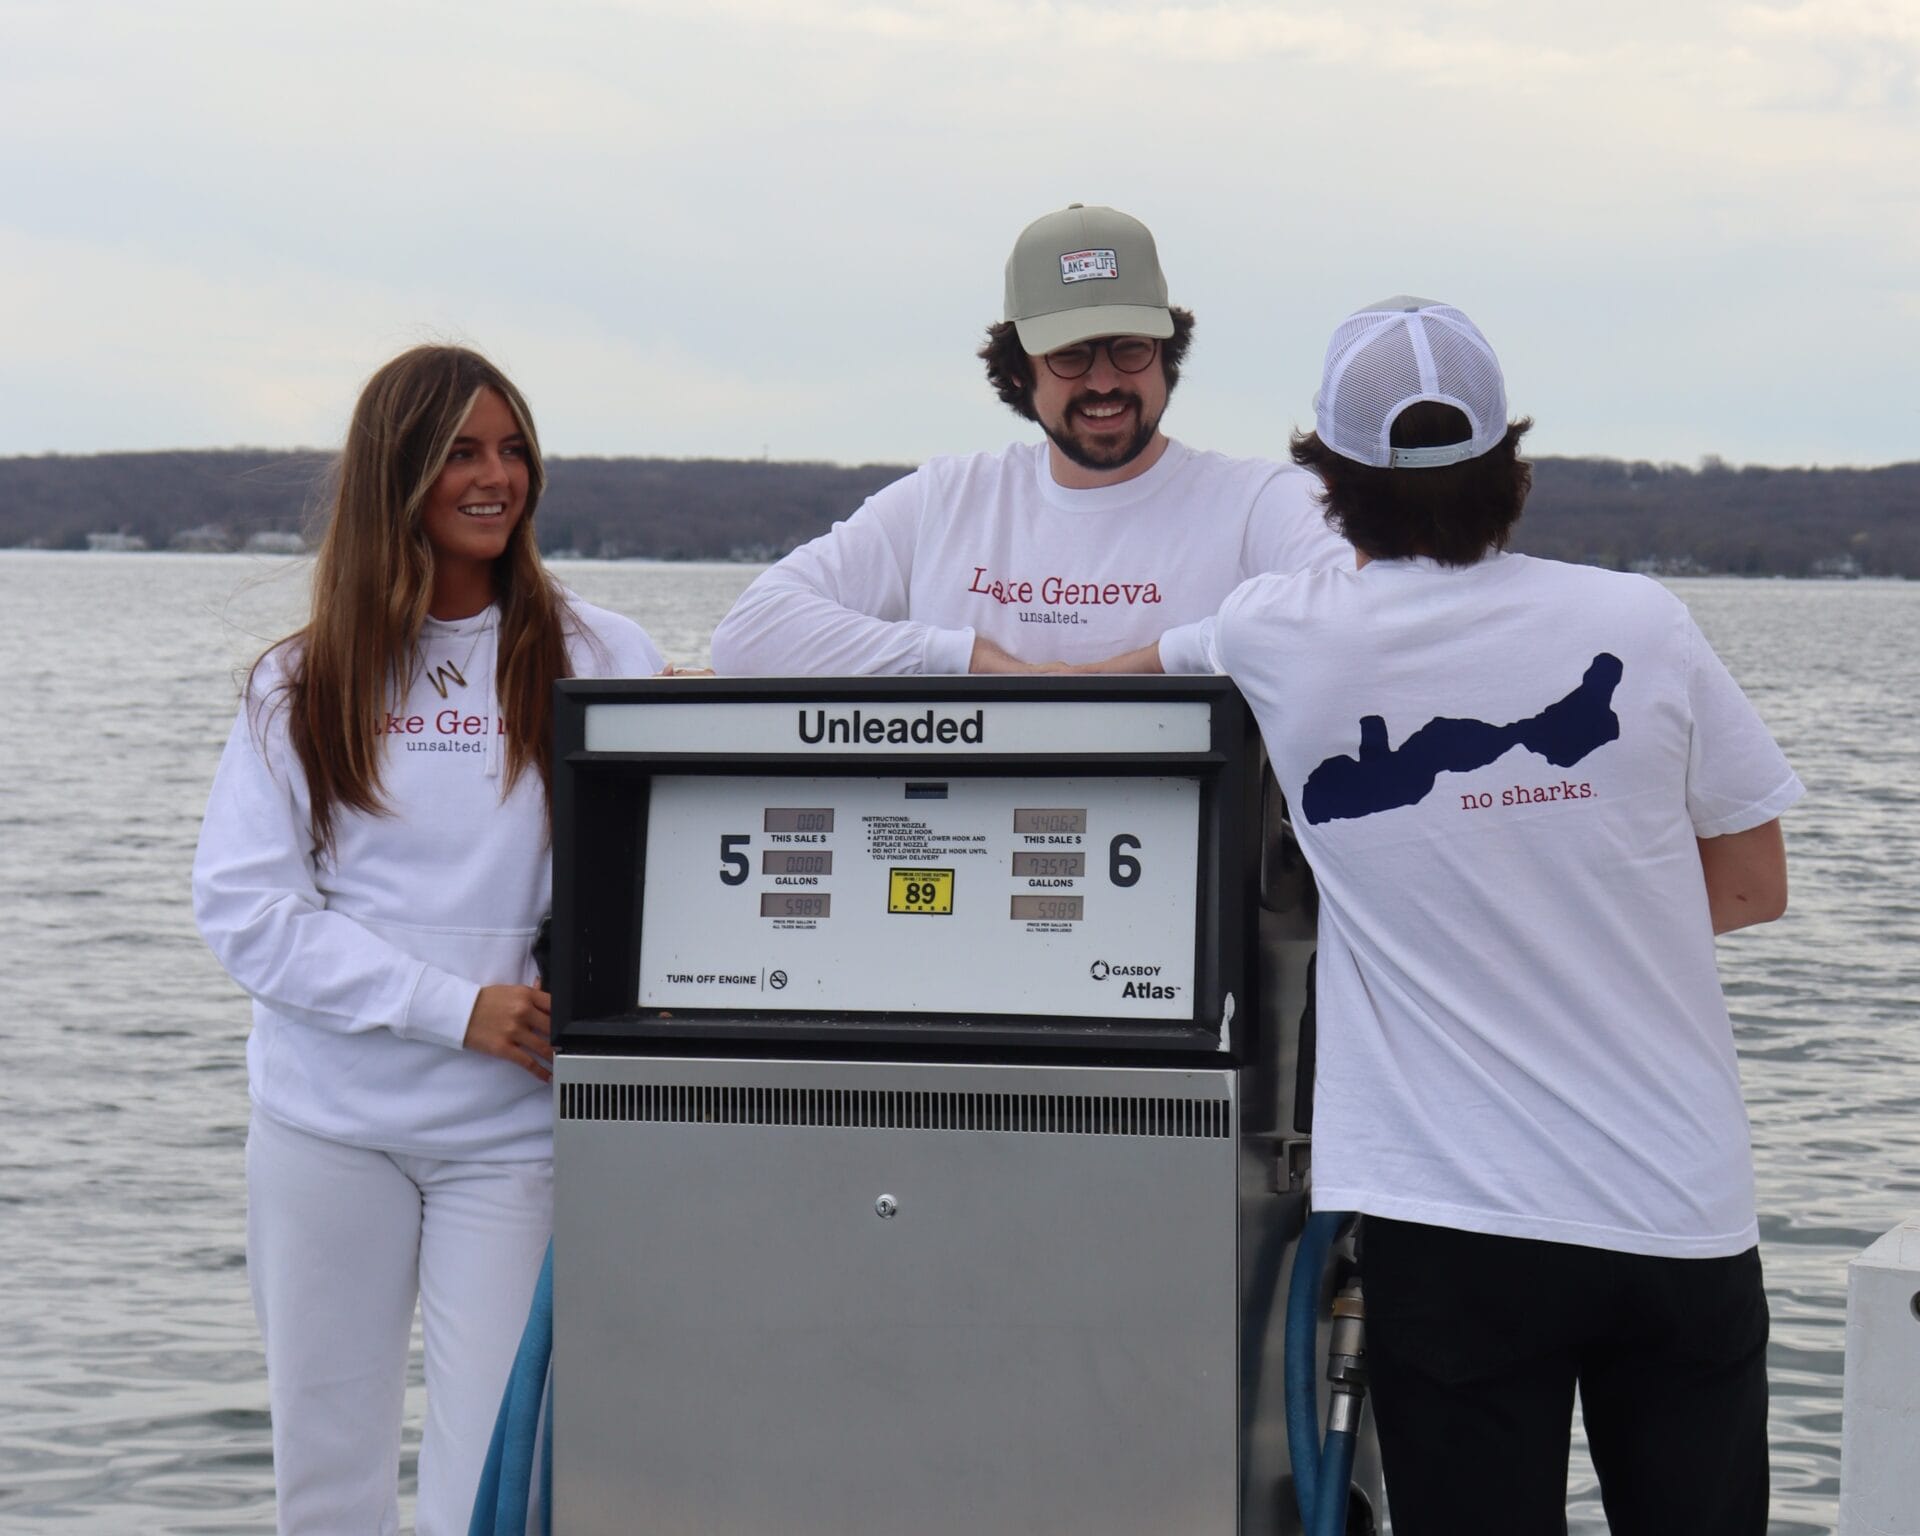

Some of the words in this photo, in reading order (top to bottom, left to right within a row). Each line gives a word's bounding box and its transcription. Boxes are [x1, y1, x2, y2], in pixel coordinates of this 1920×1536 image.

[1063, 260, 1084, 274] LAKE
[1095, 258, 1116, 270] LIFE
[968, 567, 1033, 605] Lake
[1042, 577, 1161, 605] Geneva
[799, 710, 983, 744] Unleaded
[1460, 793, 1492, 810] no
[1502, 781, 1598, 806] sharks.
[771, 835, 792, 843] THIS
[794, 835, 818, 843] SALE
[820, 835, 826, 843] $
[1024, 836, 1045, 844] THIS
[1048, 836, 1072, 844] SALE
[1076, 836, 1082, 844] $
[720, 834, 750, 886] 5
[1110, 834, 1142, 888] 6
[1028, 879, 1073, 887] GALLONS
[906, 882, 936, 904] 89
[666, 974, 693, 983] TURN
[696, 975, 716, 983] OFF
[718, 975, 756, 984] ENGINE
[1112, 966, 1161, 976] GASBOY
